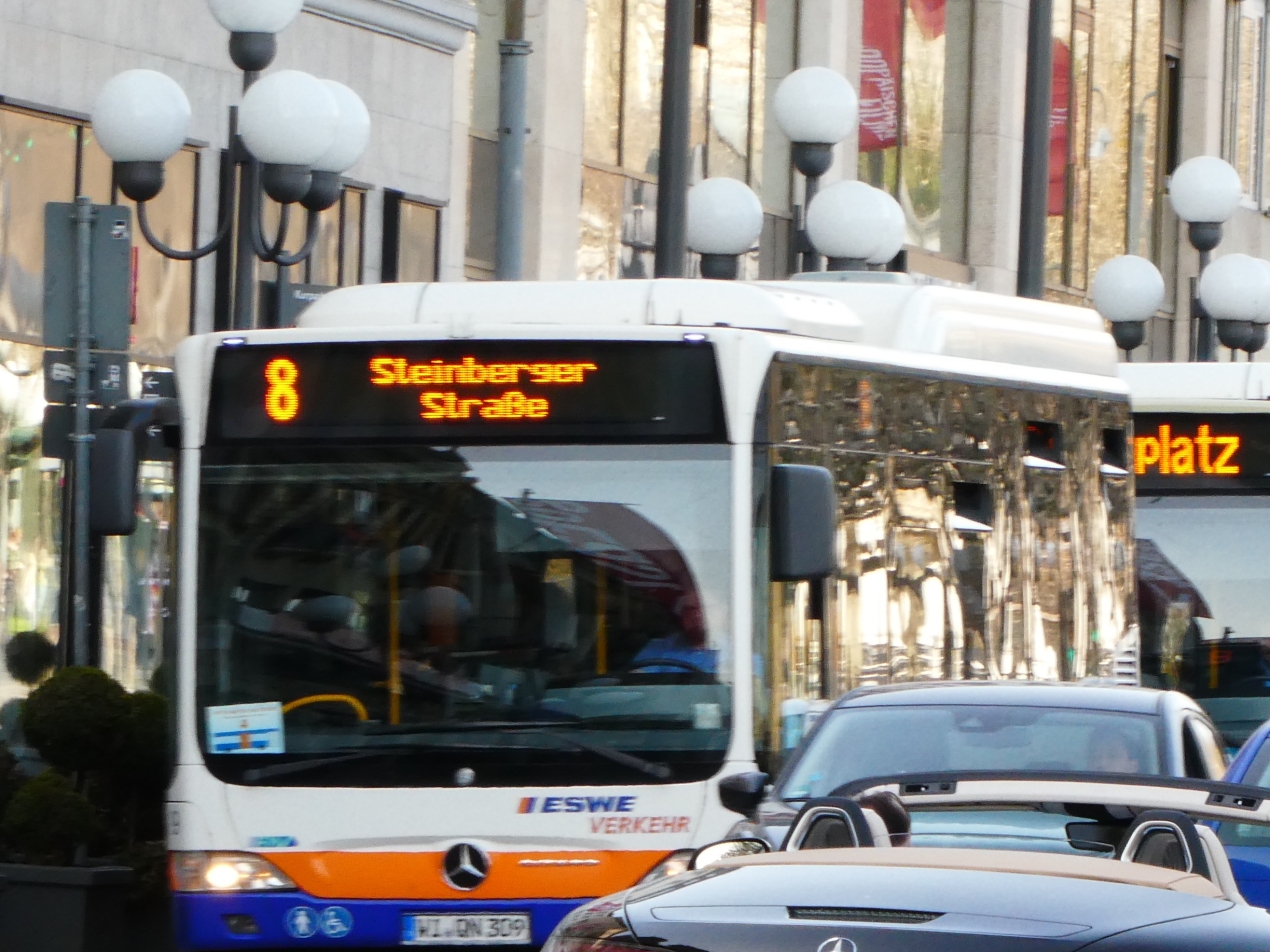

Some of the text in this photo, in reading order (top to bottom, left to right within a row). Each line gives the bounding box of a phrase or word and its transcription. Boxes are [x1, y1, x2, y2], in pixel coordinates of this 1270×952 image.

[369, 356, 598, 385] Steinberger
[264, 358, 299, 421] 8
[420, 390, 550, 419] Straße
[540, 795, 638, 813] ESWE
[589, 816, 692, 834] VERKEHR
